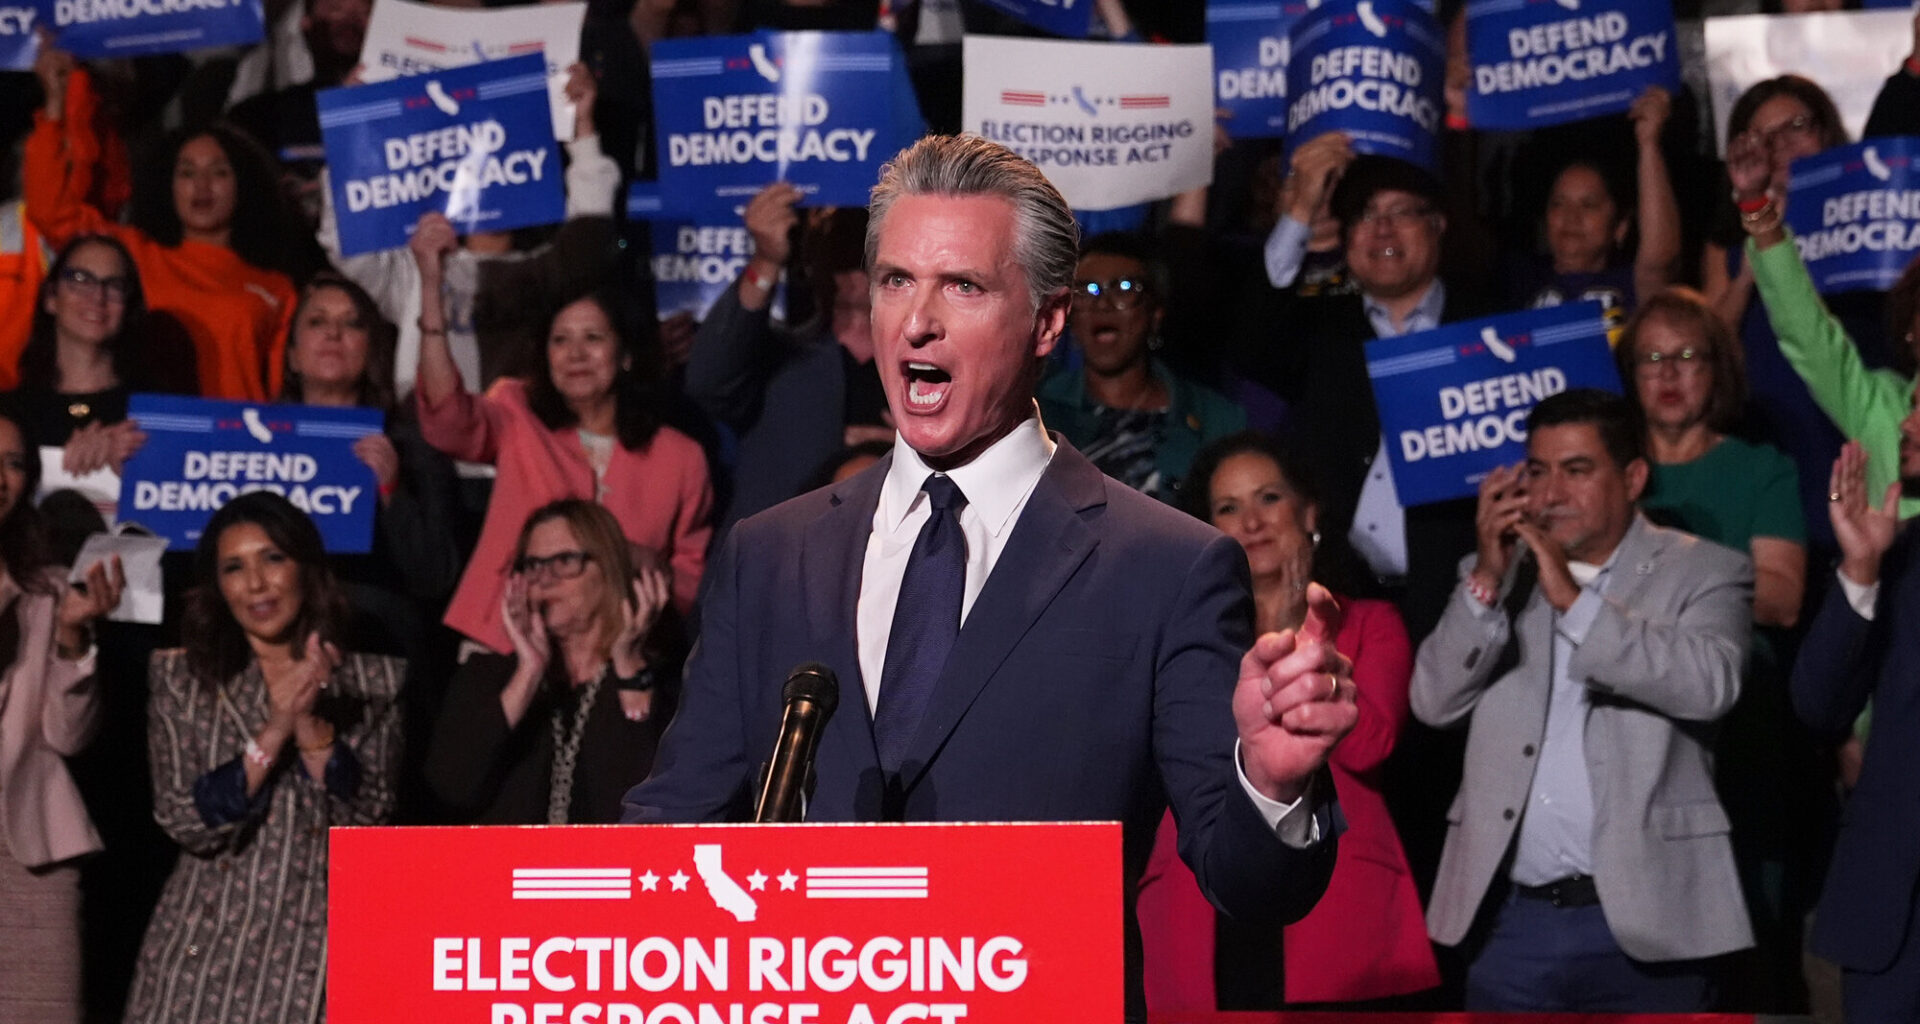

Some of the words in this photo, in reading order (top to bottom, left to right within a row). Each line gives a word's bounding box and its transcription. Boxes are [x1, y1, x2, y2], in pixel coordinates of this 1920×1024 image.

[55, 0, 243, 26] DEMOC
[1509, 11, 1627, 59] DEFEND
[1311, 46, 1421, 86] DEFEND
[1475, 31, 1668, 95] DEMOCRACY
[703, 93, 828, 129] DEFEND
[1288, 79, 1440, 134] DEMOCRAC
[384, 119, 506, 171] DEFEND
[668, 129, 876, 166] DEMOCRACY
[981, 120, 1084, 144] ELECTION
[1091, 120, 1193, 145] RIGGING
[1014, 145, 1118, 166] SPONSE
[1127, 145, 1171, 164] ACT
[1823, 188, 1920, 227] DEFEN
[677, 225, 756, 255] DEFE
[1794, 219, 1920, 261] DEMOCRA
[1439, 367, 1567, 420] DEFEND
[1400, 409, 1530, 463] DEMOC
[184, 451, 317, 482] DEFEND
[433, 936, 728, 992] ELECTION
[749, 936, 1028, 992] RIGGING
